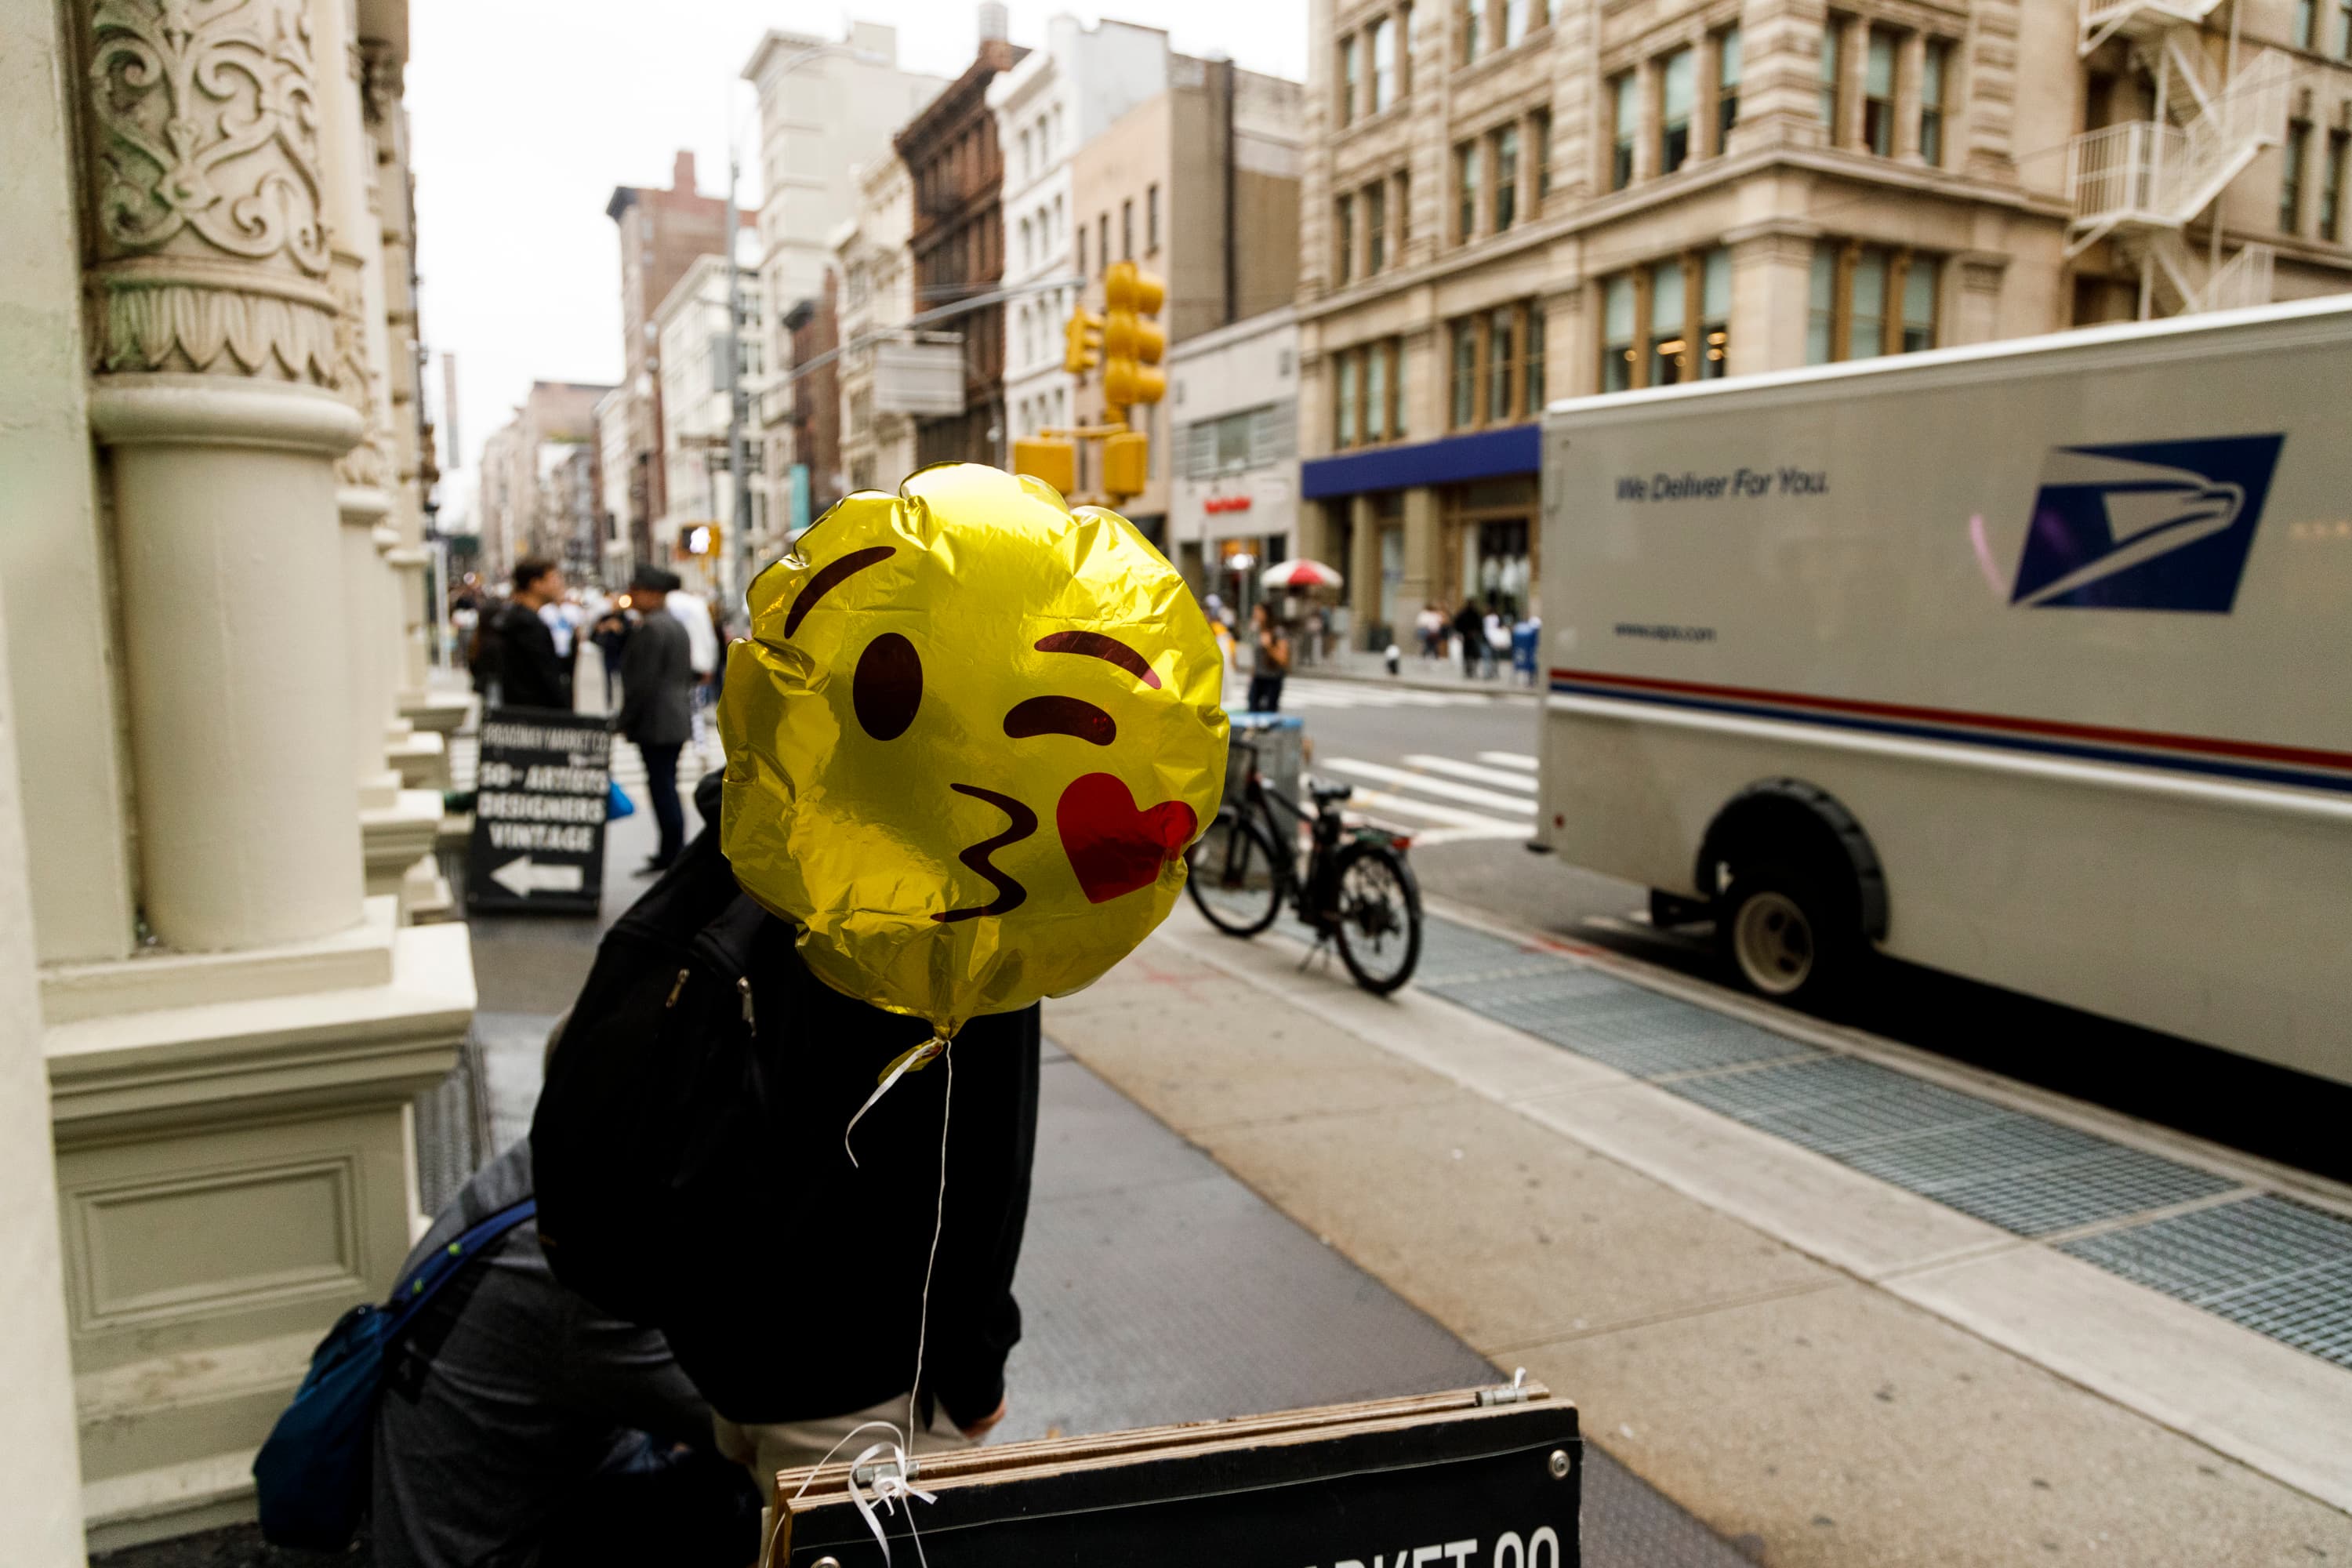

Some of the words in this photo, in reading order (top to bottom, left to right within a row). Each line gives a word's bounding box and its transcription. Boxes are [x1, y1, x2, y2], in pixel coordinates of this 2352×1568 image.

[1650, 472, 1727, 501] Deliver
[1732, 468, 1771, 496] For
[477, 791, 606, 823] DESIGNERS
[488, 823, 595, 852] VINTAGE
